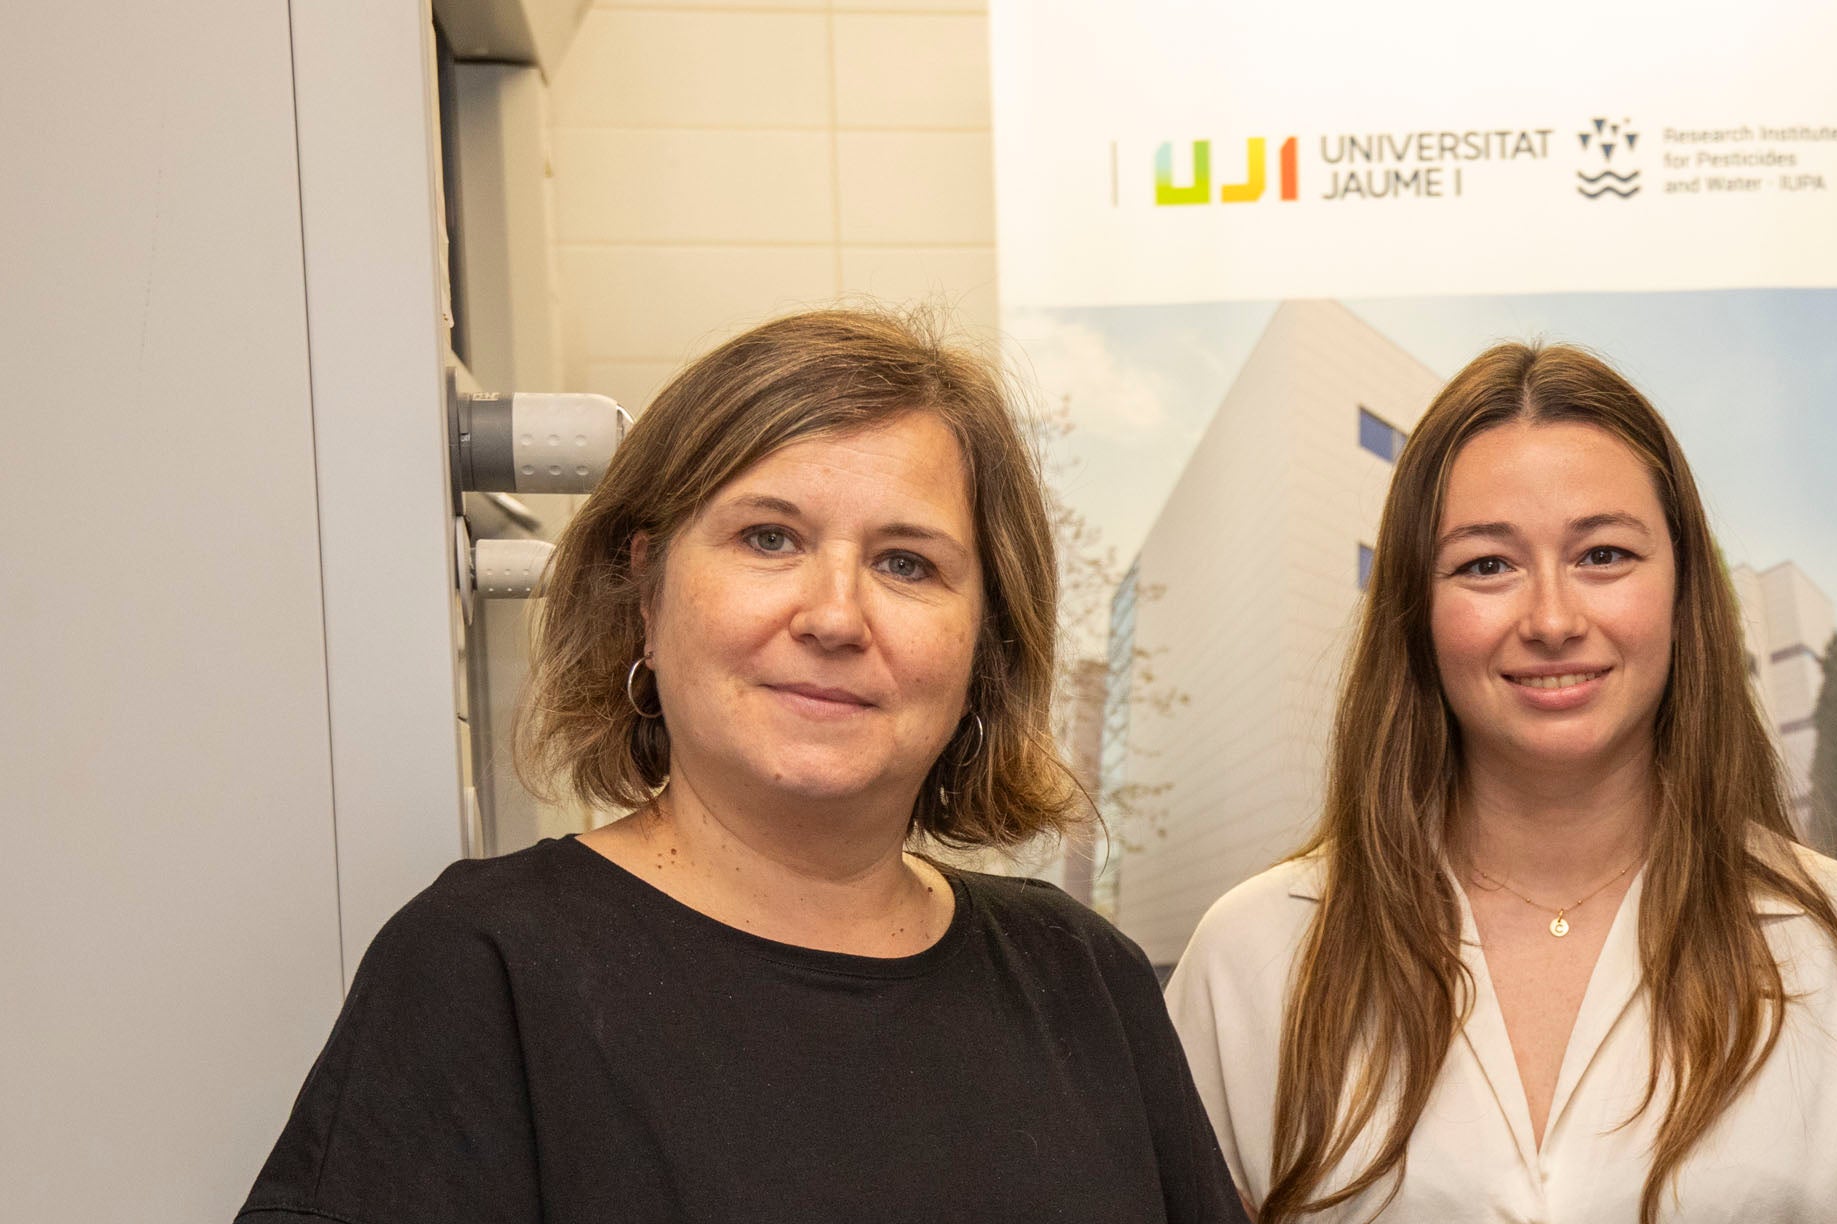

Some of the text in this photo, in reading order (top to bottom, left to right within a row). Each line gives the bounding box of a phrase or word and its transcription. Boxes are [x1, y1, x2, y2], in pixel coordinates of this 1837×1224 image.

[1663, 127, 1752, 143] Research
[1320, 129, 1555, 164] UNIVERSITAT
[1663, 150, 1797, 168] for Pesticides
[1322, 167, 1463, 200] JAUME I
[1665, 177, 1700, 193] and
[1706, 176, 1761, 191] Water
